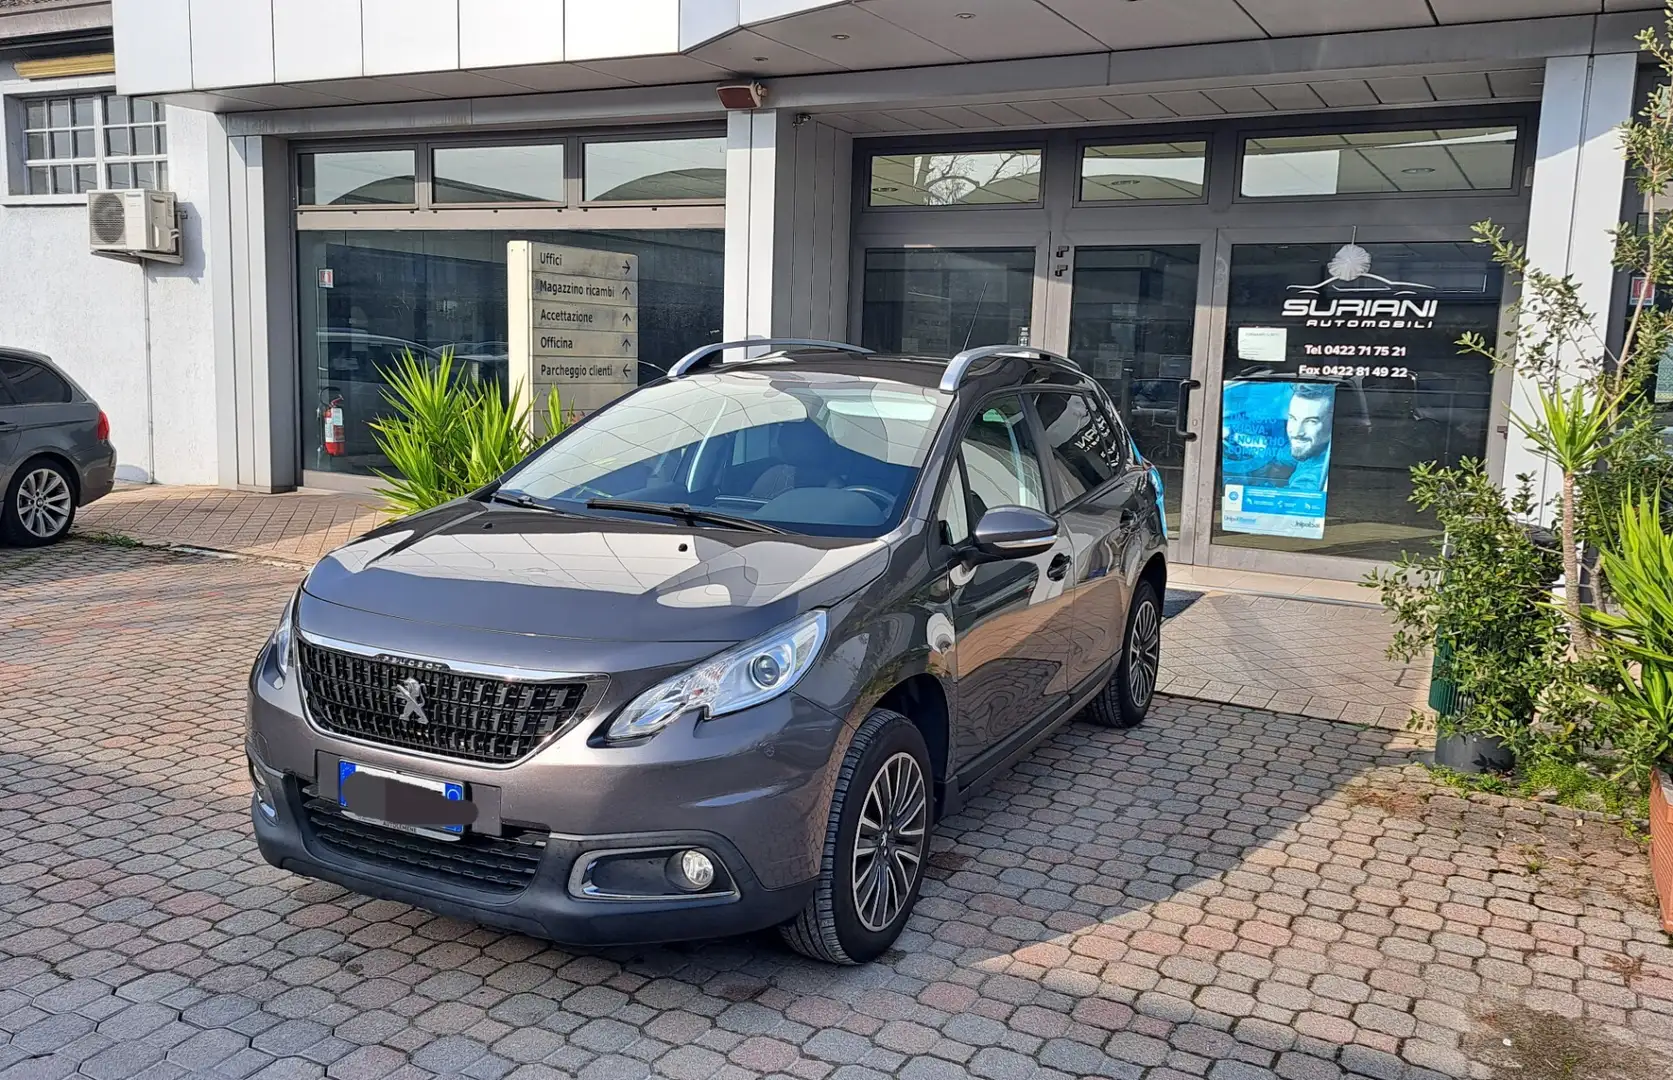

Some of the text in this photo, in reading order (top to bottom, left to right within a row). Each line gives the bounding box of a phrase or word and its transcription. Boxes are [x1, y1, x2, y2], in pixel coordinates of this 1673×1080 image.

[539, 252, 562, 266] Uffici
[540, 280, 615, 297] Magazzino ricambi
[1281, 299, 1438, 318] SURIANI
[540, 309, 593, 323] Accettazione
[1306, 319, 1433, 329] AUTOMOBILI
[540, 336, 573, 349] Officina
[1304, 344, 1407, 356] Tel 0422 71 75 21
[540, 364, 613, 379] Parcheggio clienti
[1299, 364, 1408, 378] Fax 0422 81 49 22
